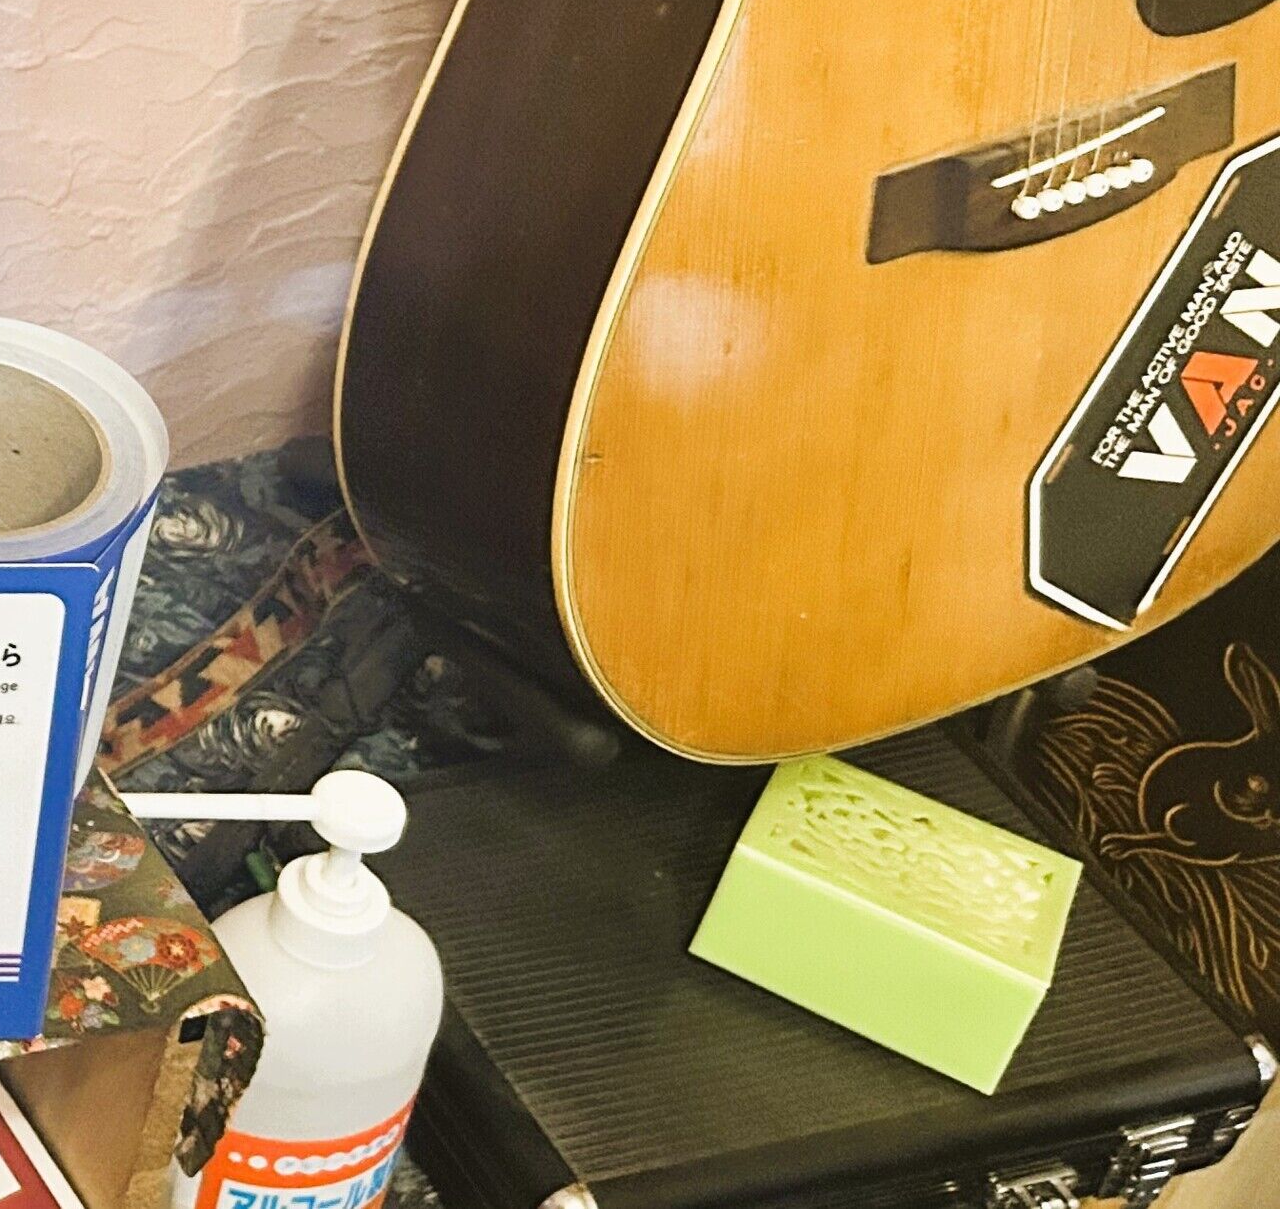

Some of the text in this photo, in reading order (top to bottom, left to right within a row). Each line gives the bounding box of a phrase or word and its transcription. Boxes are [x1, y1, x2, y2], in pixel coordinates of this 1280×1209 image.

[1091, 230, 1246, 466] FOR THE ACTIVE MAN AND
[1102, 239, 1254, 471] THE MAN OF GOOD TASTE
